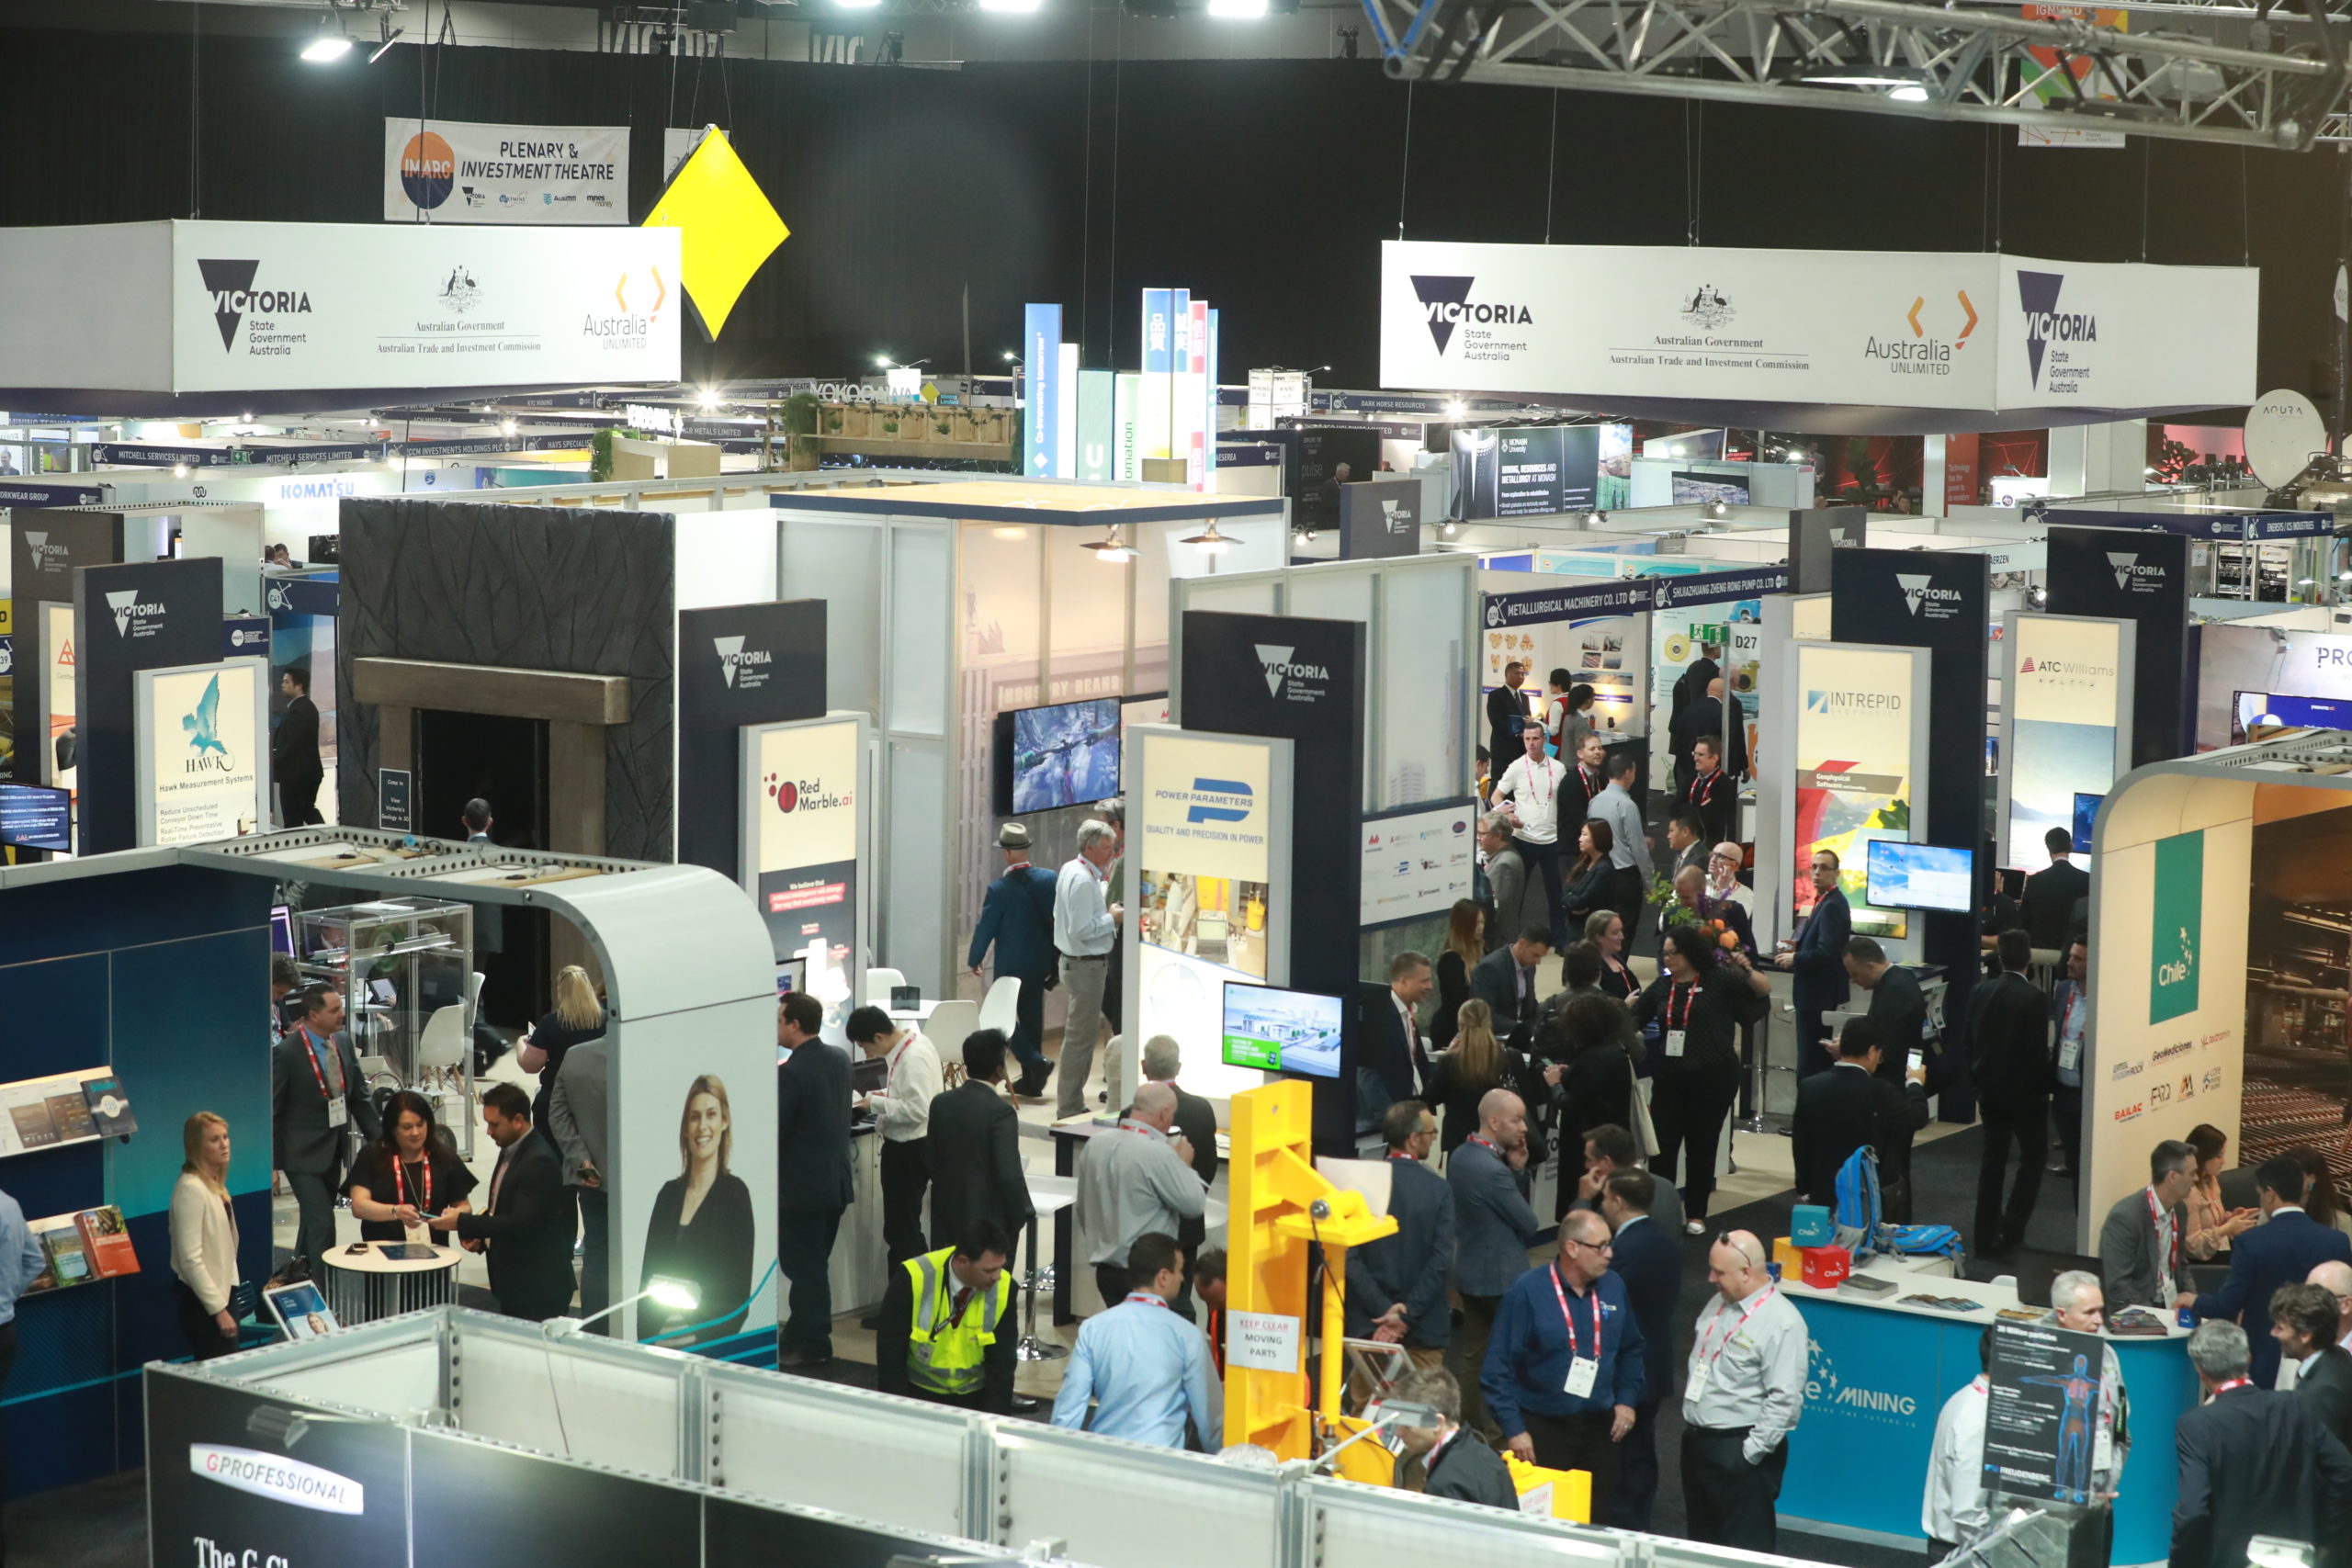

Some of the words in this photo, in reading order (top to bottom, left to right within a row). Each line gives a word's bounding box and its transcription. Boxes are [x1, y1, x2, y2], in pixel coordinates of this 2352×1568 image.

[500, 141, 563, 159] PLENARY
[569, 143, 579, 158] &
[404, 158, 451, 180] IMARC
[460, 161, 553, 180] INVESTMENT
[555, 164, 615, 180] THEATRE
[208, 289, 312, 314] VICTORIA
[1419, 300, 1533, 324] VICTORIA
[249, 321, 275, 331] State
[414, 321, 456, 332] Australian
[457, 321, 504, 331] Government
[583, 313, 647, 336] Australia
[2022, 311, 2098, 343] VICTORIA
[249, 333, 307, 344] Government
[1464, 329, 1492, 339] State
[377, 344, 415, 354] Australian
[417, 344, 439, 354] Trade
[441, 343, 455, 353] and
[457, 342, 496, 353] Investment
[497, 341, 541, 352] Commission
[603, 337, 647, 350] UNLIMITED
[1464, 340, 1528, 351] Government
[1654, 335, 1702, 346] Australian
[1704, 336, 1764, 349] Government
[1865, 335, 1951, 361] Australia
[249, 345, 291, 355] Australia
[1464, 351, 1510, 362] Australia
[2051, 349, 2069, 363] State
[1609, 355, 1655, 365] Australian
[1657, 355, 1683, 367] Trade
[1685, 356, 1702, 367] and
[1704, 356, 1754, 369] Investment
[1756, 358, 1810, 370] Commission
[1891, 362, 1951, 376] UNLIMITED
[2050, 366, 2090, 379] Government
[810, 381, 914, 404] YOKOGAWA
[2049, 381, 2078, 394] Australia
[718, 428, 741, 436] LIMITED
[119, 450, 146, 460] MITCHELL
[147, 452, 175, 462] SERVICES
[176, 453, 200, 463] LIMITED
[266, 453, 297, 463] MITCHELL
[298, 452, 327, 462] SERVICES
[328, 450, 353, 460] LIMITED
[422, 445, 461, 456] INVESTMENTS
[462, 444, 492, 454] HOLDINGS
[492, 443, 503, 452] PLC
[1538, 473, 1556, 482] MONASH
[281, 479, 355, 499] KOMATSU
[28, 492, 50, 502] GROUP
[2113, 564, 2165, 577] VICTORIA
[1673, 583, 1710, 599] SHIJIAZHUANG
[1710, 581, 1726, 594] ZHENG
[1726, 580, 1741, 592] RONG
[1741, 578, 1756, 591] PUMP
[1756, 576, 1765, 589] CO.
[1765, 575, 1774, 588] LTD
[1902, 588, 1962, 601] VICTORIA
[112, 603, 166, 618] VICTORIA
[1508, 596, 1563, 617] METALLURGICAL
[1564, 594, 1603, 613] MACHINERY
[1604, 595, 1614, 606] CO.
[1616, 592, 1627, 604] LTD
[1736, 635, 1758, 649] D27
[720, 650, 772, 667] VICTORIA
[1261, 661, 1329, 680] VICTORIA
[2039, 660, 2061, 673] ATC
[2063, 661, 2114, 677] Williams
[1831, 692, 1901, 710] INTREPID
[186, 750, 234, 773] HAWK
[159, 784, 178, 793] Hawk
[179, 778, 224, 791] Measurement
[225, 773, 253, 785] Systems
[799, 778, 820, 795] Red
[799, 791, 853, 811] Marble.ai
[1156, 790, 1189, 801] POWER
[1190, 792, 1253, 807] PARAMETERS
[160, 808, 181, 817] Reduce
[187, 814, 204, 822] Down
[205, 811, 219, 819] Time
[1146, 825, 1174, 836] QUALITY
[1176, 828, 1191, 837] AND
[1192, 829, 1228, 841] PRECISION
[1230, 832, 1238, 842] IN
[1238, 833, 1264, 845] POWER
[2158, 961, 2186, 987] Chile
[1798, 1227, 1815, 1236] Chile
[1825, 1269, 1840, 1278] Chile
[1239, 1319, 1261, 1329] KEEP
[1262, 1321, 1289, 1331] CLEAR
[1245, 1334, 1283, 1345] MOVING
[1250, 1348, 1277, 1358] PARTS
[1835, 1386, 1917, 1416] MINING
[194, 1536, 236, 1568] The
